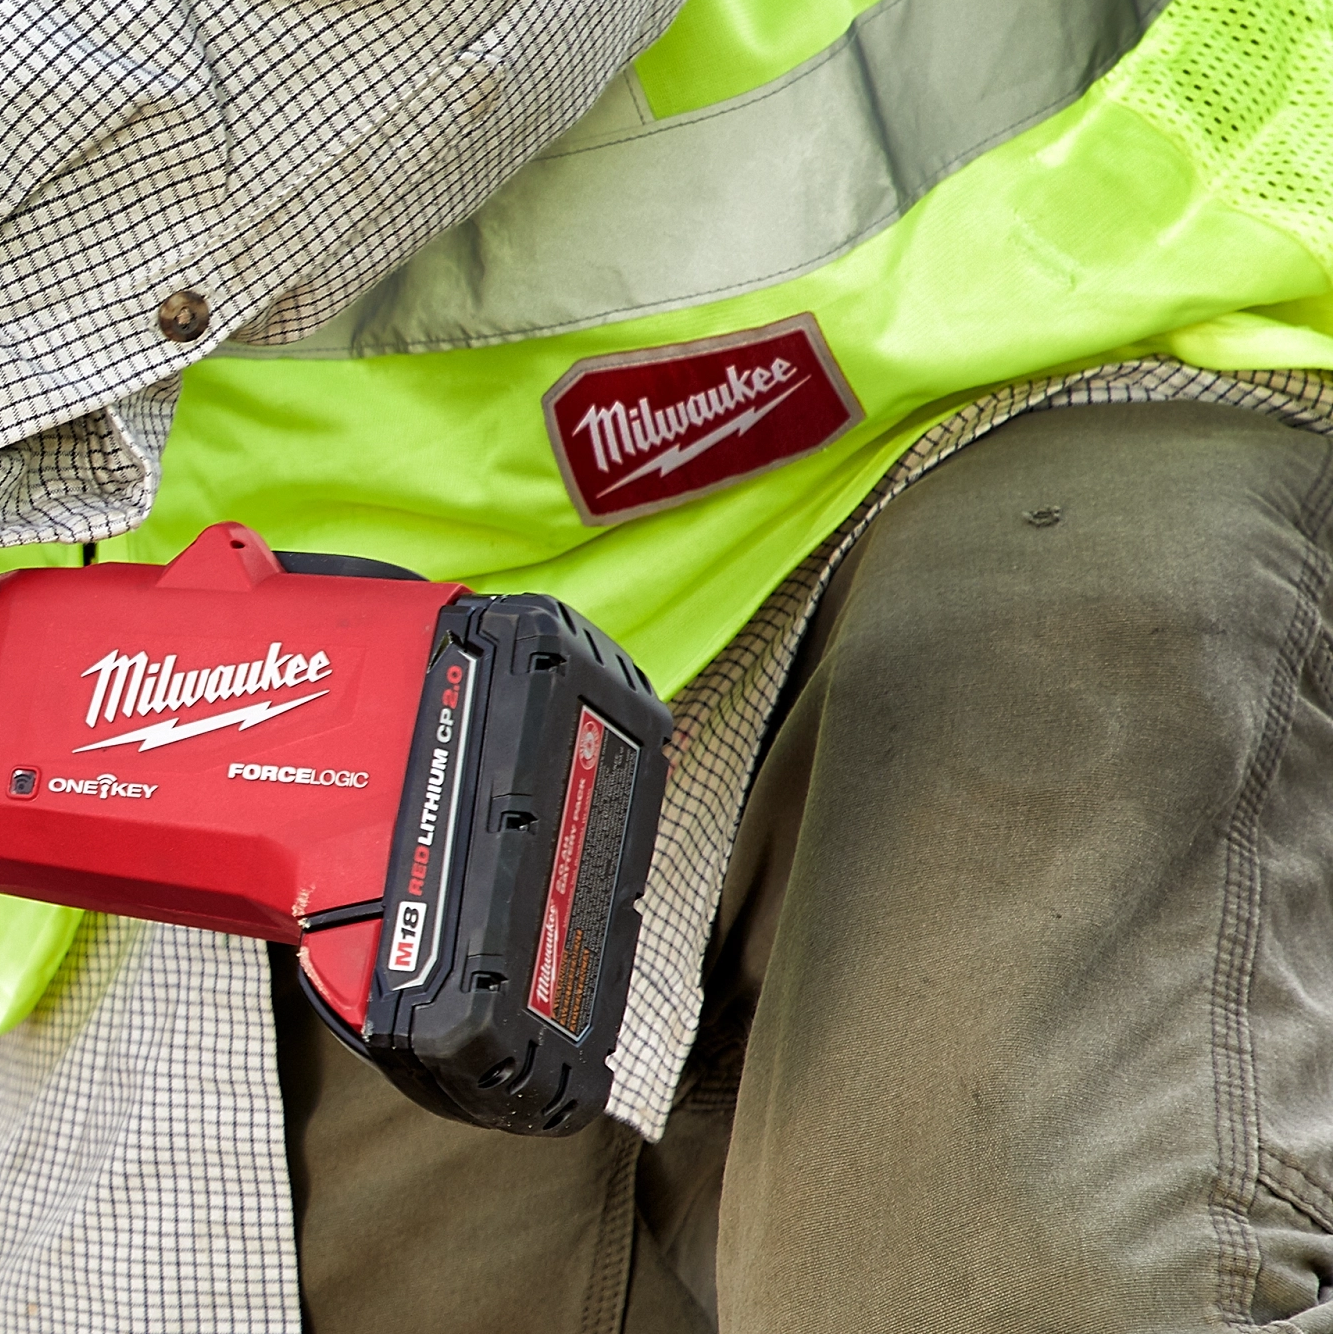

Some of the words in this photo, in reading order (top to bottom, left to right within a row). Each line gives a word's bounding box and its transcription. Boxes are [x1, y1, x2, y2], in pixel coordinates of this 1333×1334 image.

[572, 358, 797, 473] Milwaukee
[80, 642, 333, 728] Milwaukee
[227, 763, 370, 788] FORCELOGIC
[573, 778, 586, 821] PACK
[395, 906, 420, 967] M18
